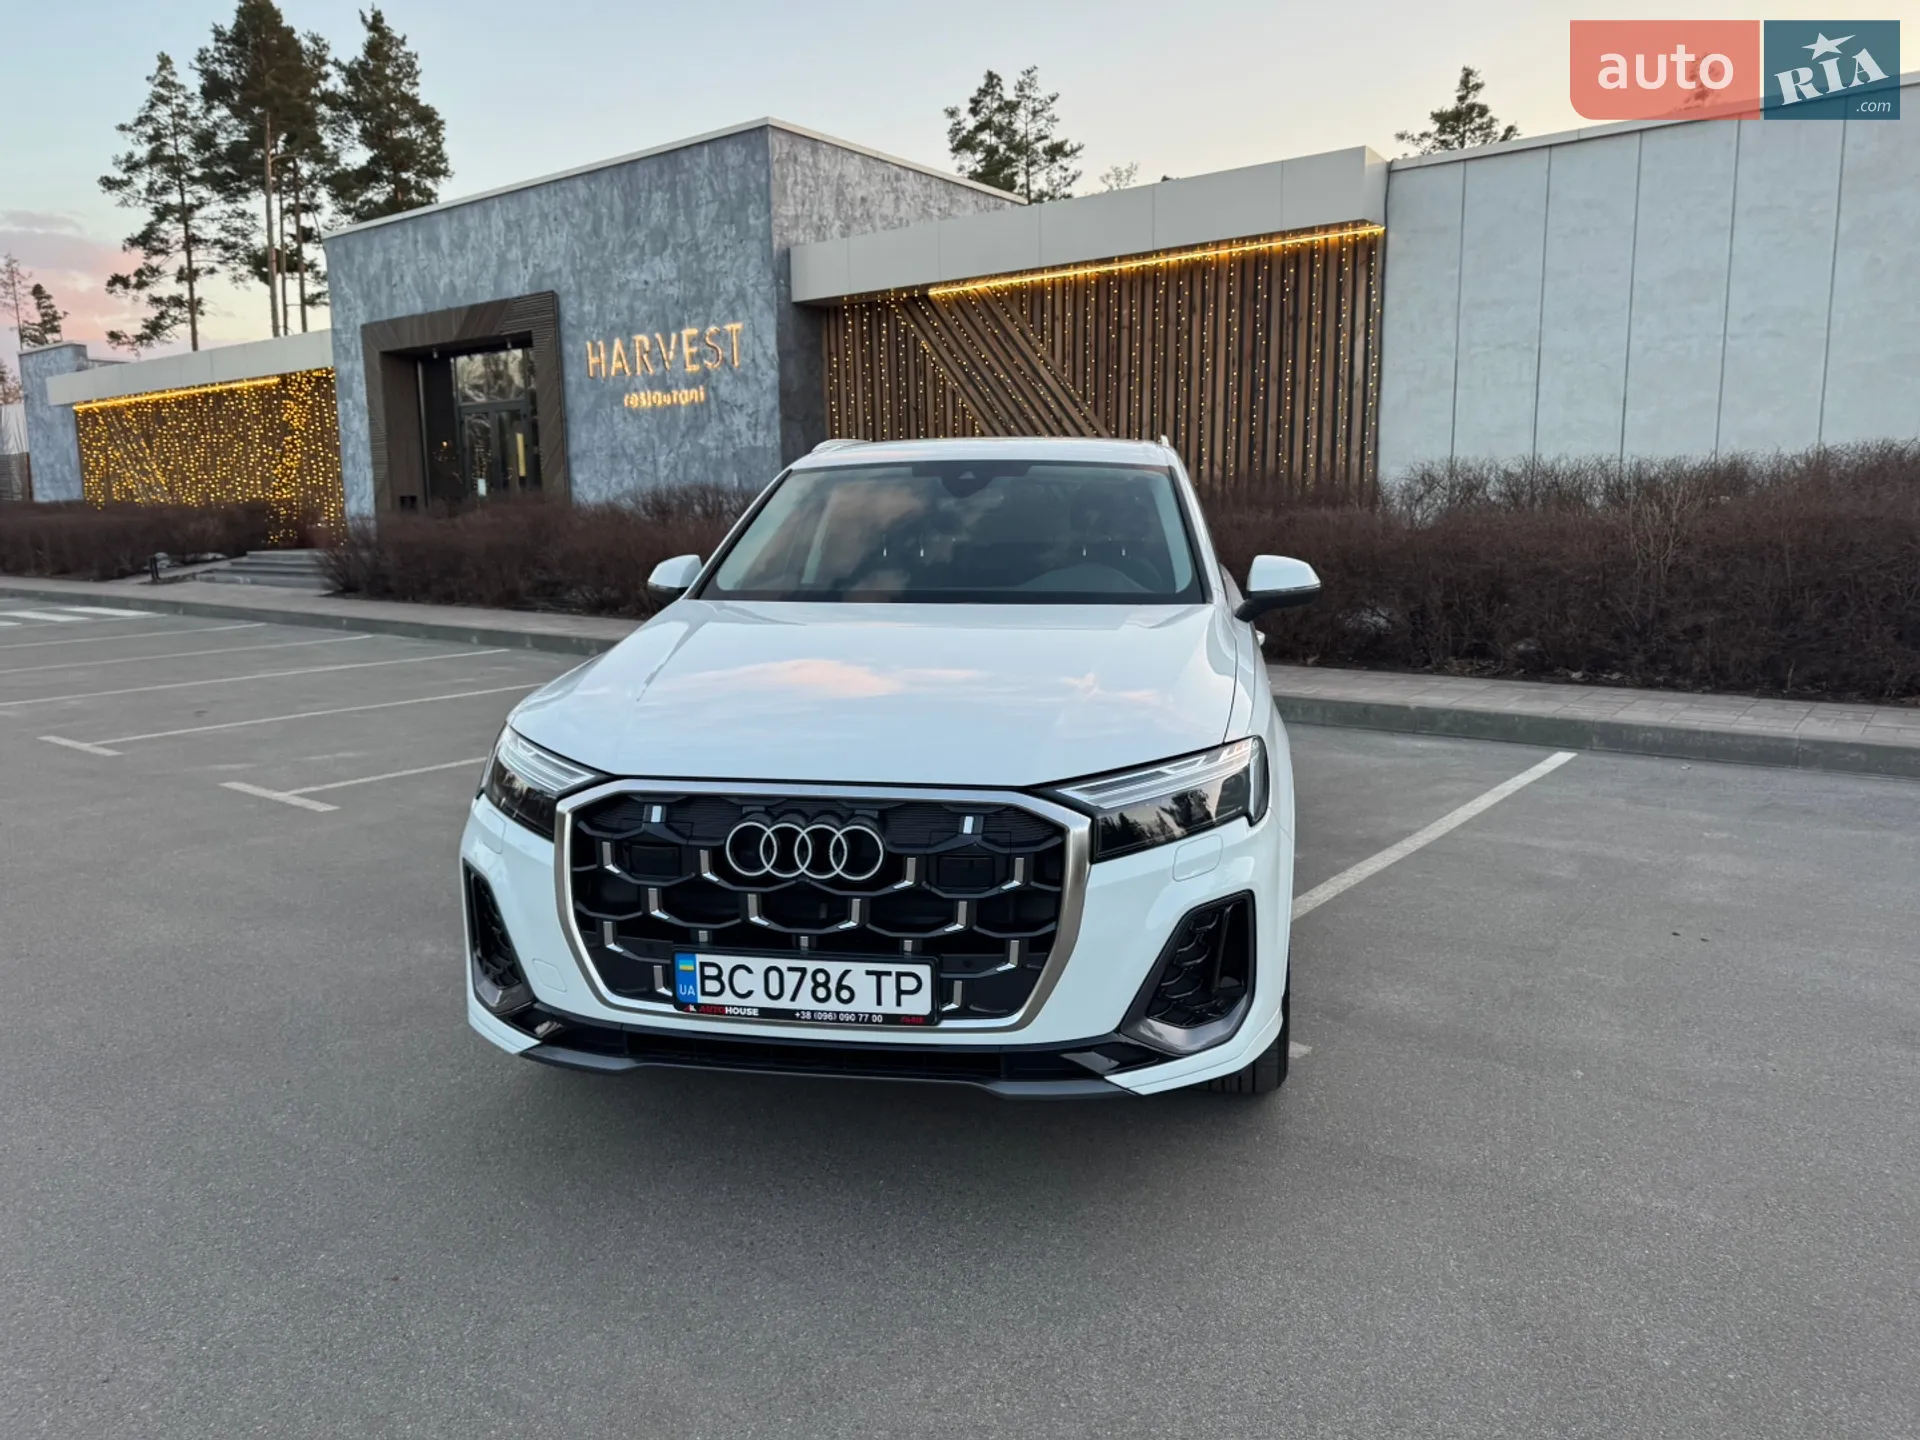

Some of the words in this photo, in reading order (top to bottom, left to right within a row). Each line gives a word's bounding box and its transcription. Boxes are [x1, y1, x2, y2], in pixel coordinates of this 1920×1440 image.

[586, 322, 744, 379] HARVEST
[623, 385, 705, 408] restaurant
[679, 983, 696, 996] UA
[699, 961, 754, 999] BC
[763, 966, 856, 1004] 0786
[865, 970, 923, 1007] TP
[794, 1010, 812, 1020] +38
[857, 1013, 869, 1022] 77
[871, 1014, 883, 1023] 00
